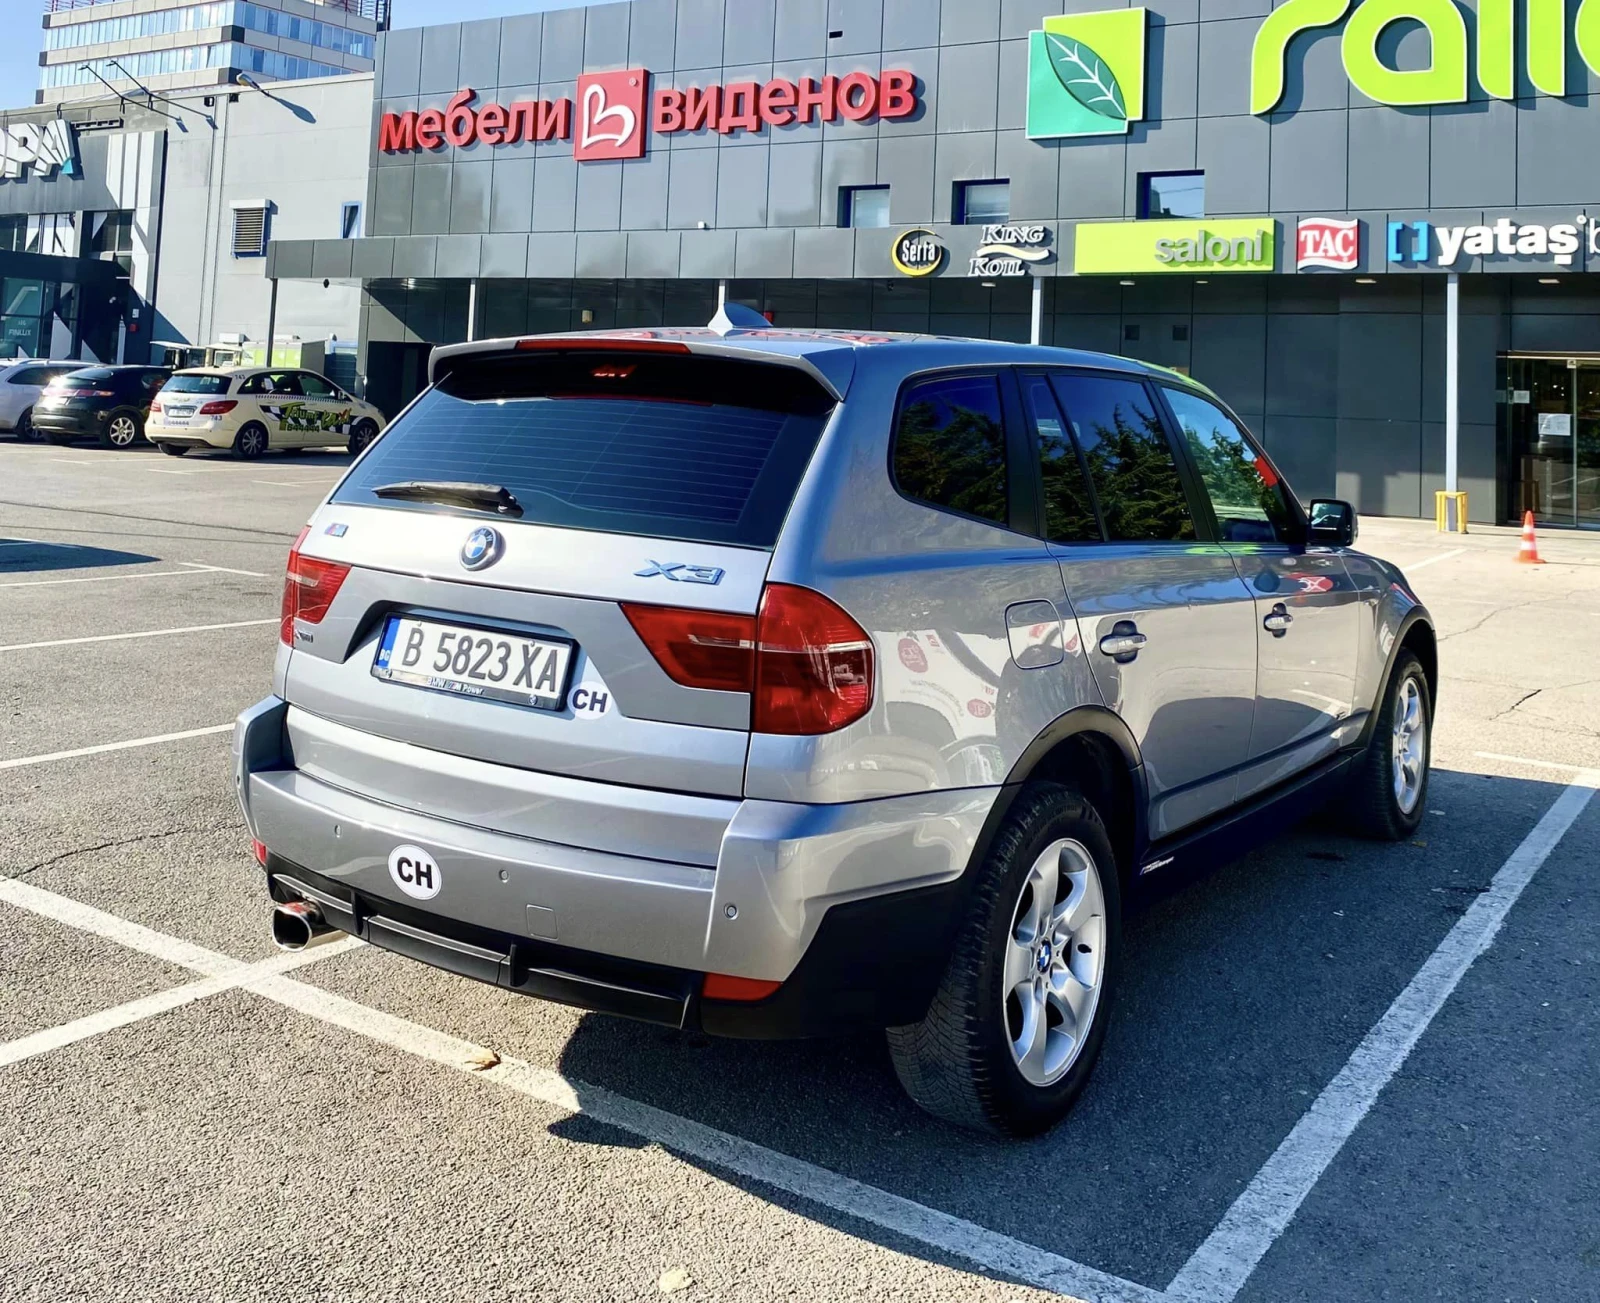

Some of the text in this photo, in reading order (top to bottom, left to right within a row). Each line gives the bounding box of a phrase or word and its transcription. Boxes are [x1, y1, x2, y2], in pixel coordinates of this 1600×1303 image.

[378, 70, 919, 152] мебели виденов
[0, 119, 74, 179] РА
[902, 240, 935, 262] Serta
[1155, 229, 1262, 263] saloni
[1300, 229, 1354, 262] TAÇ
[633, 559, 727, 586] X3
[379, 649, 391, 661] BG
[402, 627, 558, 692] B 5823 XA
[573, 688, 608, 713] CH
[397, 857, 433, 889] CH
